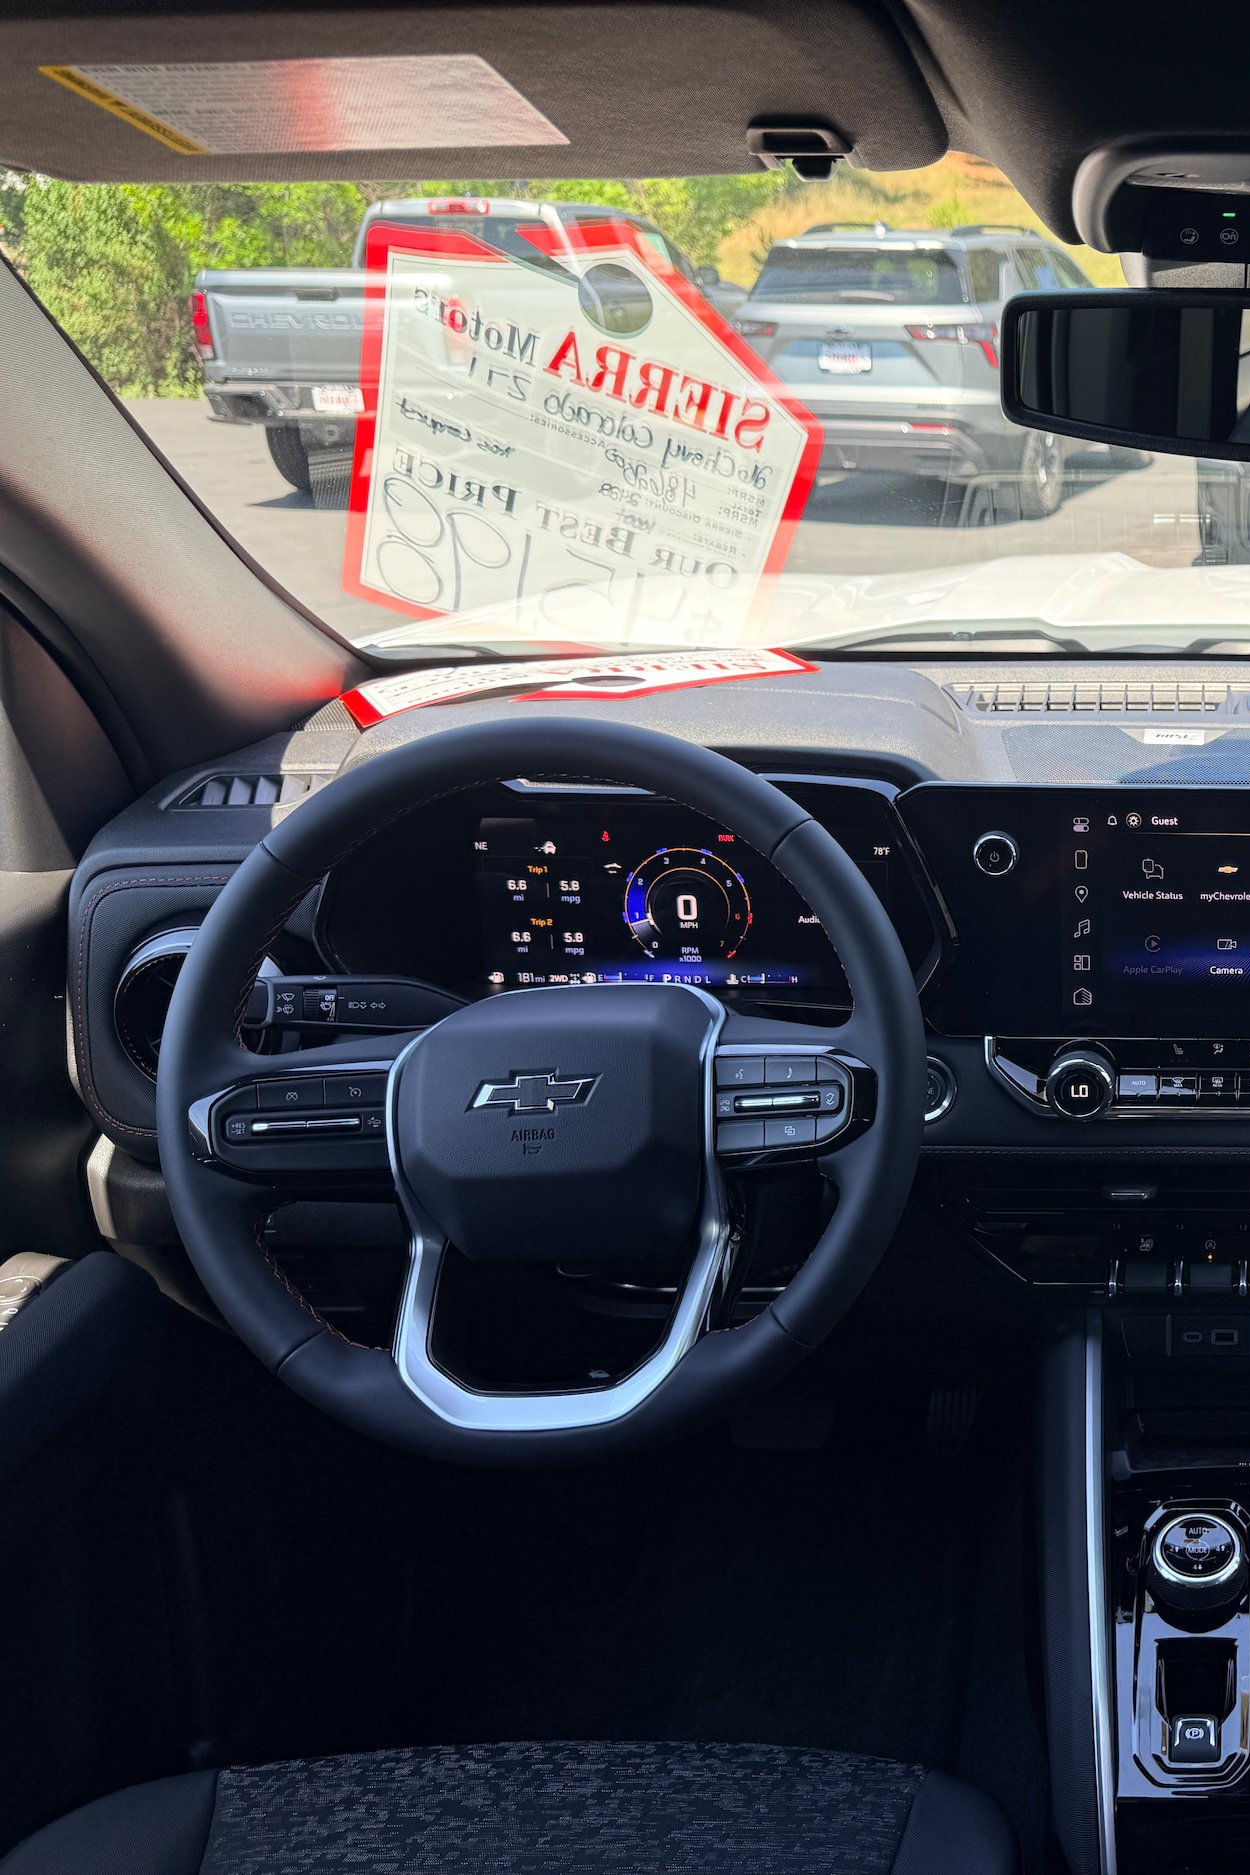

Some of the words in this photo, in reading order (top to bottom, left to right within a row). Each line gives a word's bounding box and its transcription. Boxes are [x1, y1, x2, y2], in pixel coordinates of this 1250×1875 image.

[1151, 816, 1178, 826] Guest
[474, 841, 488, 851] NE
[527, 865, 543, 875] Trip
[507, 880, 528, 891] 6.6
[559, 880, 580, 891] 5.8
[561, 895, 581, 904] mpg
[1122, 890, 1154, 900] Vehicle
[1155, 891, 1183, 900] Status
[676, 894, 698, 921] 0
[530, 918, 546, 927] Trip
[511, 931, 532, 942] 6.6
[563, 932, 584, 943] 5.8
[565, 947, 584, 955] mpg
[1123, 965, 1148, 975] Apple
[1150, 965, 1183, 976] CarPlay
[1209, 965, 1244, 975] Camera
[549, 974, 569, 983] 2WD
[1070, 1084, 1089, 1098] LO
[511, 1128, 555, 1142] AIRBAG
[1188, 1527, 1209, 1535] AUTO
